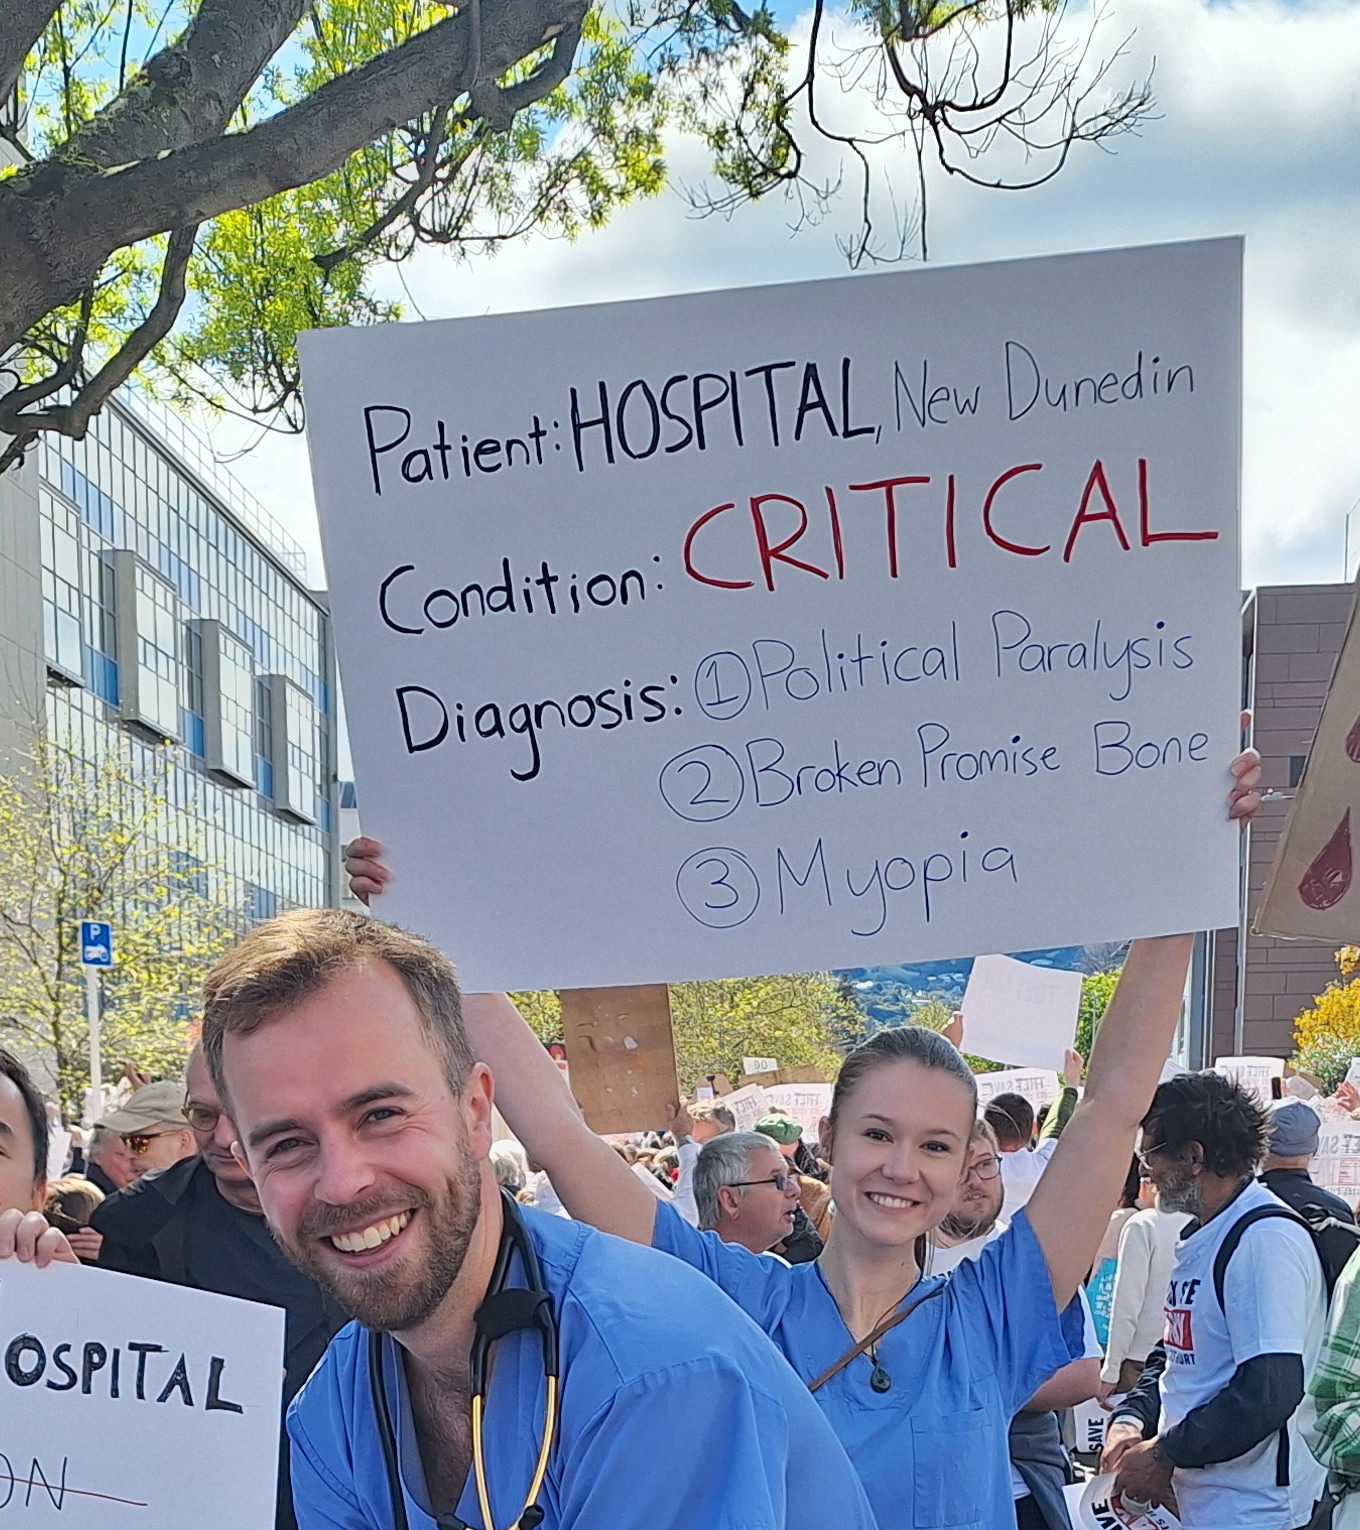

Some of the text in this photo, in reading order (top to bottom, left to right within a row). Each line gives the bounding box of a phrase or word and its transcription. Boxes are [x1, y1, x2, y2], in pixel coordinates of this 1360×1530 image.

[364, 340, 1195, 495] Patient: HOSPITAL, New Dunedin
[379, 458, 1219, 635] Condition: CRITICAL
[395, 675, 681, 781] Diagnosis:
[751, 621, 960, 713] Political
[991, 610, 1195, 699] Paralysis
[745, 737, 901, 807] Broken
[919, 724, 1060, 792] Promise
[1095, 720, 1209, 776] Bone
[90, 924, 101, 940] P
[778, 831, 1017, 936] Myopia
[1088, 1417, 1104, 1453] SAVE
